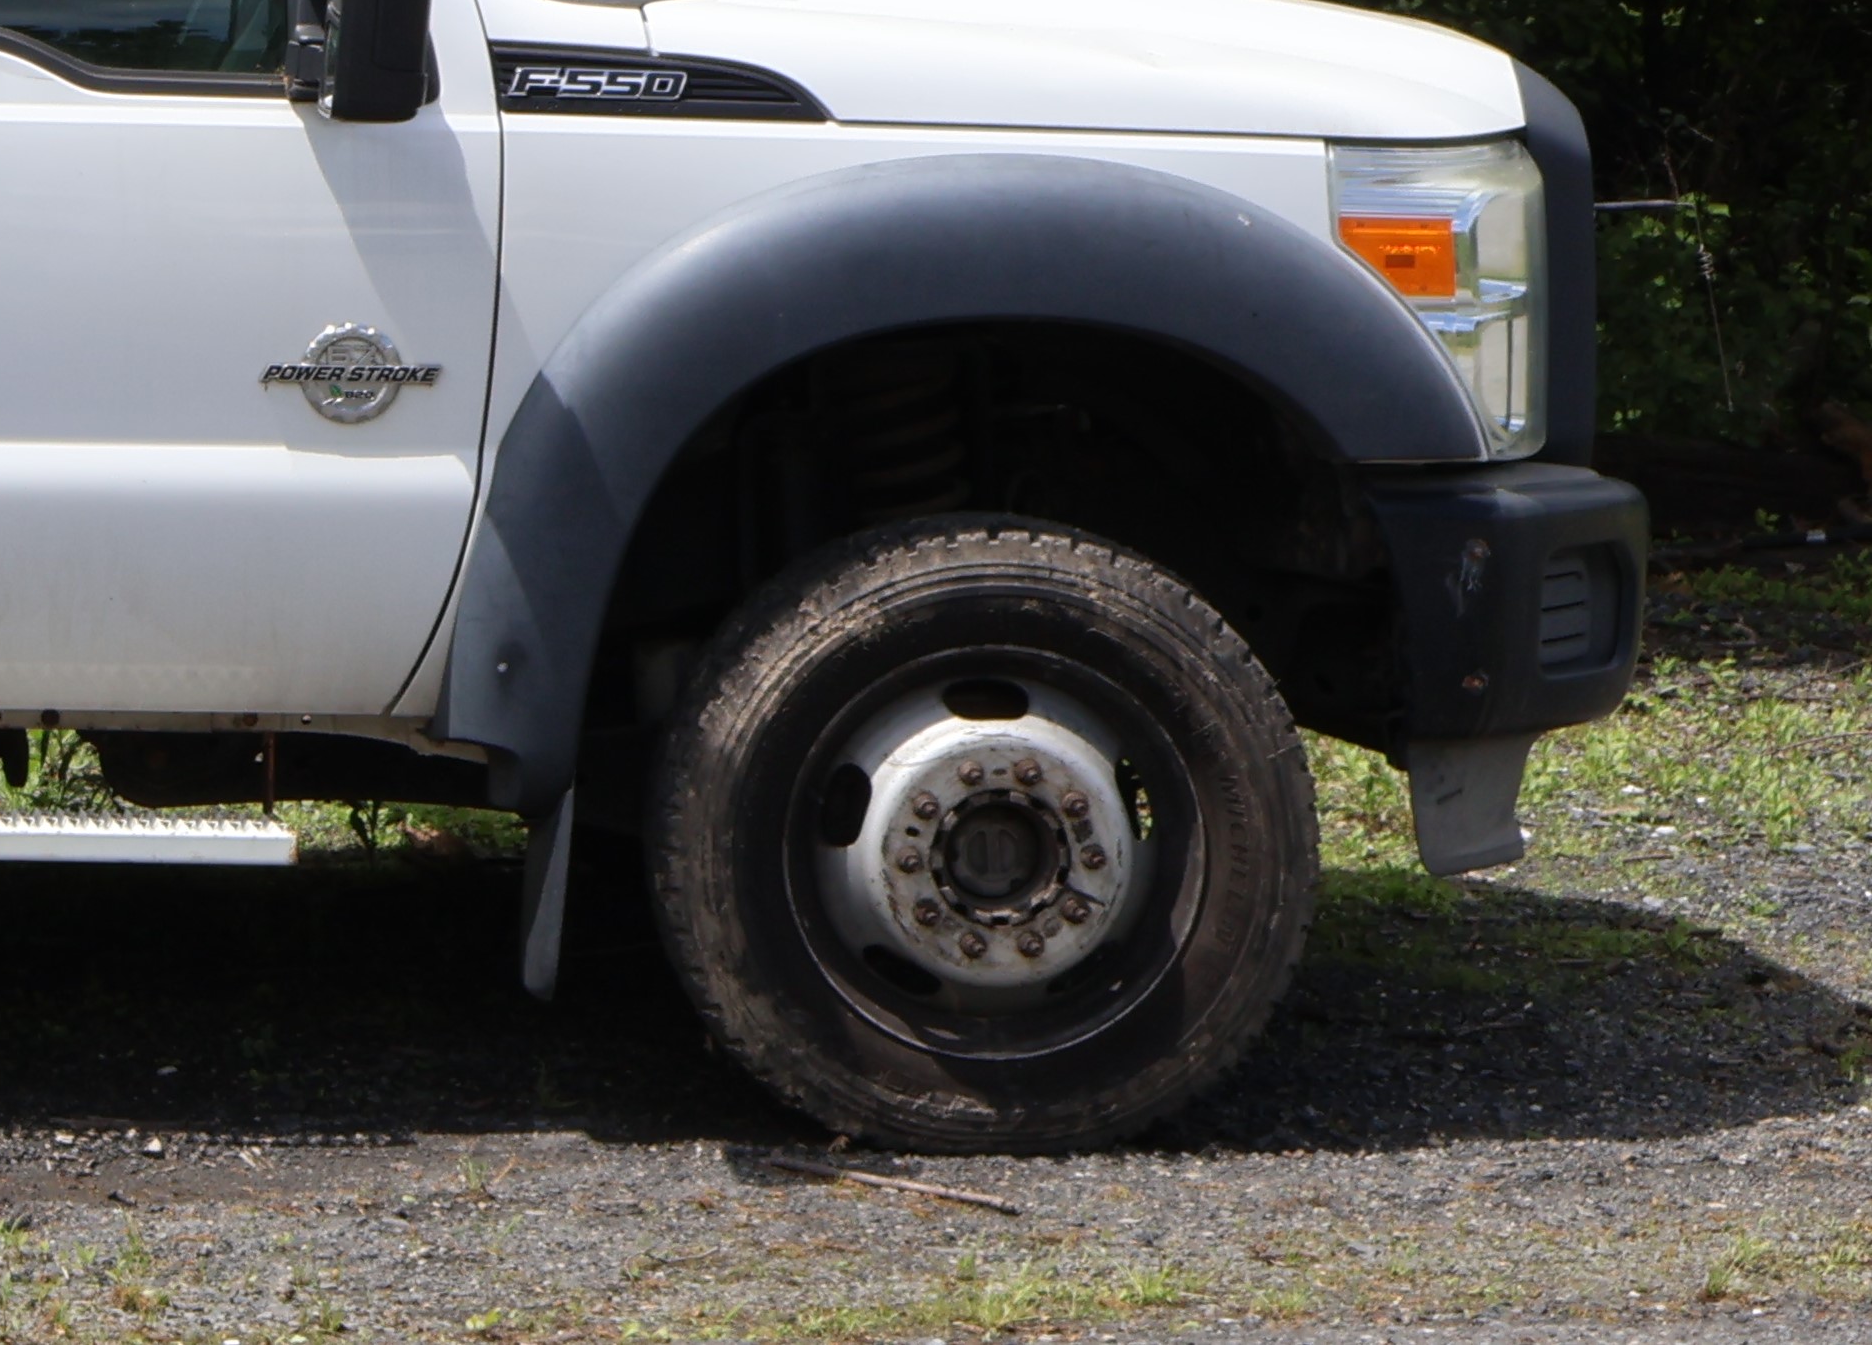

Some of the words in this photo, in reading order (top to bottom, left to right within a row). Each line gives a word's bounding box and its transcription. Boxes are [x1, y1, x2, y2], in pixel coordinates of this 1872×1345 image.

[508, 67, 687, 100] F-550
[261, 364, 346, 383] POWER
[347, 365, 441, 384] STROKE
